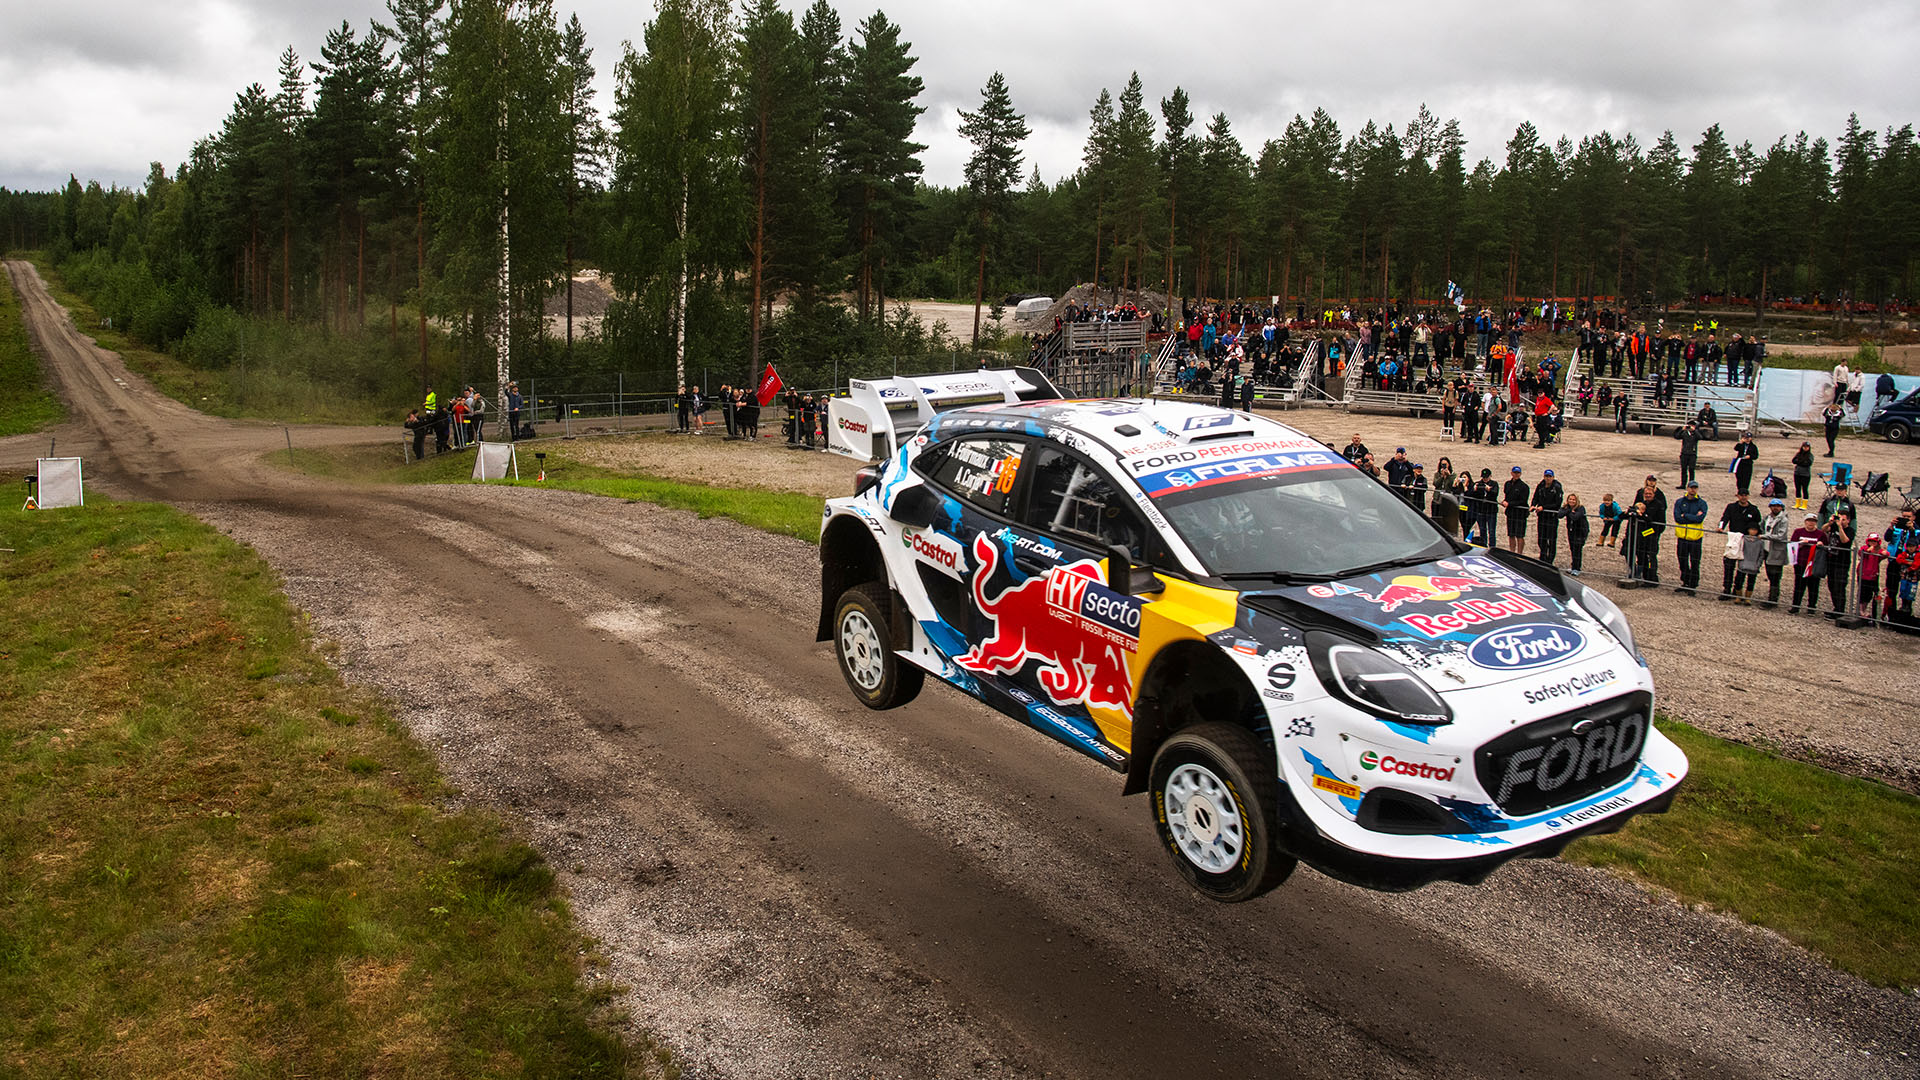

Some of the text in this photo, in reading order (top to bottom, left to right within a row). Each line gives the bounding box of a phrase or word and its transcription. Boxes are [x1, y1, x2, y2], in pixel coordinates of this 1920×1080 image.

[844, 419, 868, 434] Castrol
[1132, 439, 1319, 472] FORD PERFORMANCE
[1190, 452, 1333, 481] FORUM8
[995, 455, 1021, 494] 16
[912, 533, 957, 569] Castrol
[1049, 570, 1141, 629] HY secto
[1080, 620, 1126, 647] FOSSIL-FREE
[1487, 628, 1572, 665] Ford
[1523, 669, 1616, 705] SafetyCulture
[1086, 738, 1126, 761] HYBRID
[1496, 713, 1644, 804] FORD
[1380, 755, 1456, 782] Castrol
[1316, 777, 1357, 797] PIRELLI
[1560, 796, 1634, 825] Fleetback
